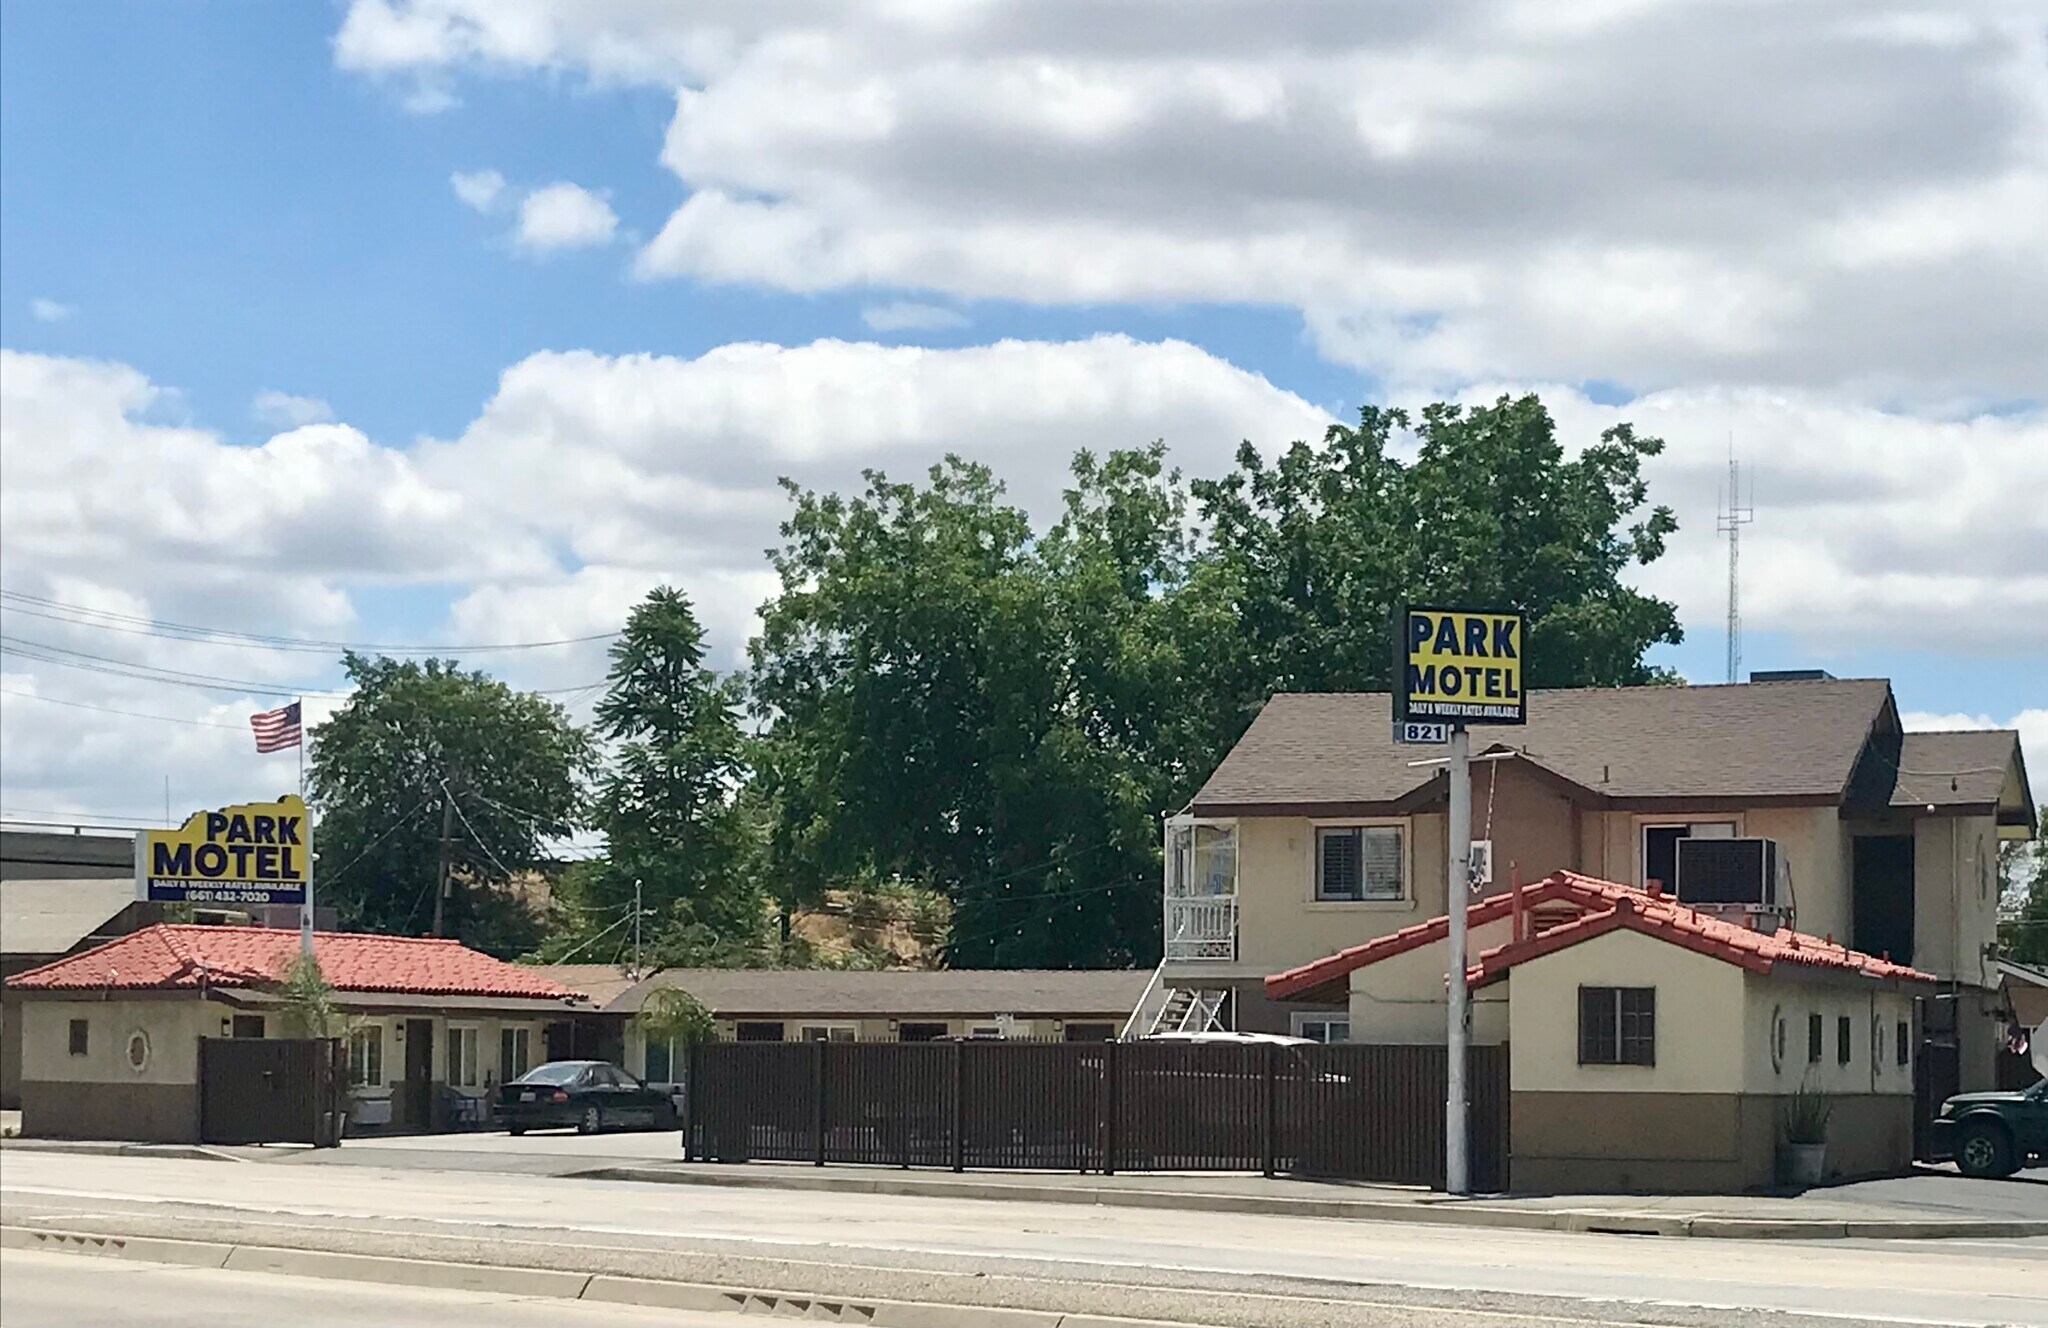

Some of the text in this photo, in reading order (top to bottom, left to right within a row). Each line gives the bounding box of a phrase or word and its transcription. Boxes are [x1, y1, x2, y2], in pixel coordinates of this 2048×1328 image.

[1410, 614, 1518, 659] PARK
[1409, 664, 1519, 699] MOTEL
[1435, 703, 1461, 716] WEEKLY
[1462, 704, 1482, 716] RATES
[1483, 705, 1519, 718] AVAILABLE
[1407, 725, 1442, 739] 821
[206, 812, 302, 846] PARK
[153, 842, 301, 879] MOTEL
[153, 879, 179, 888] DAILY
[188, 880, 224, 889] WEEKLY
[224, 882, 252, 890] RATES
[253, 882, 300, 891] AVAILABLE
[185, 890, 270, 902] (661) 432-7020
